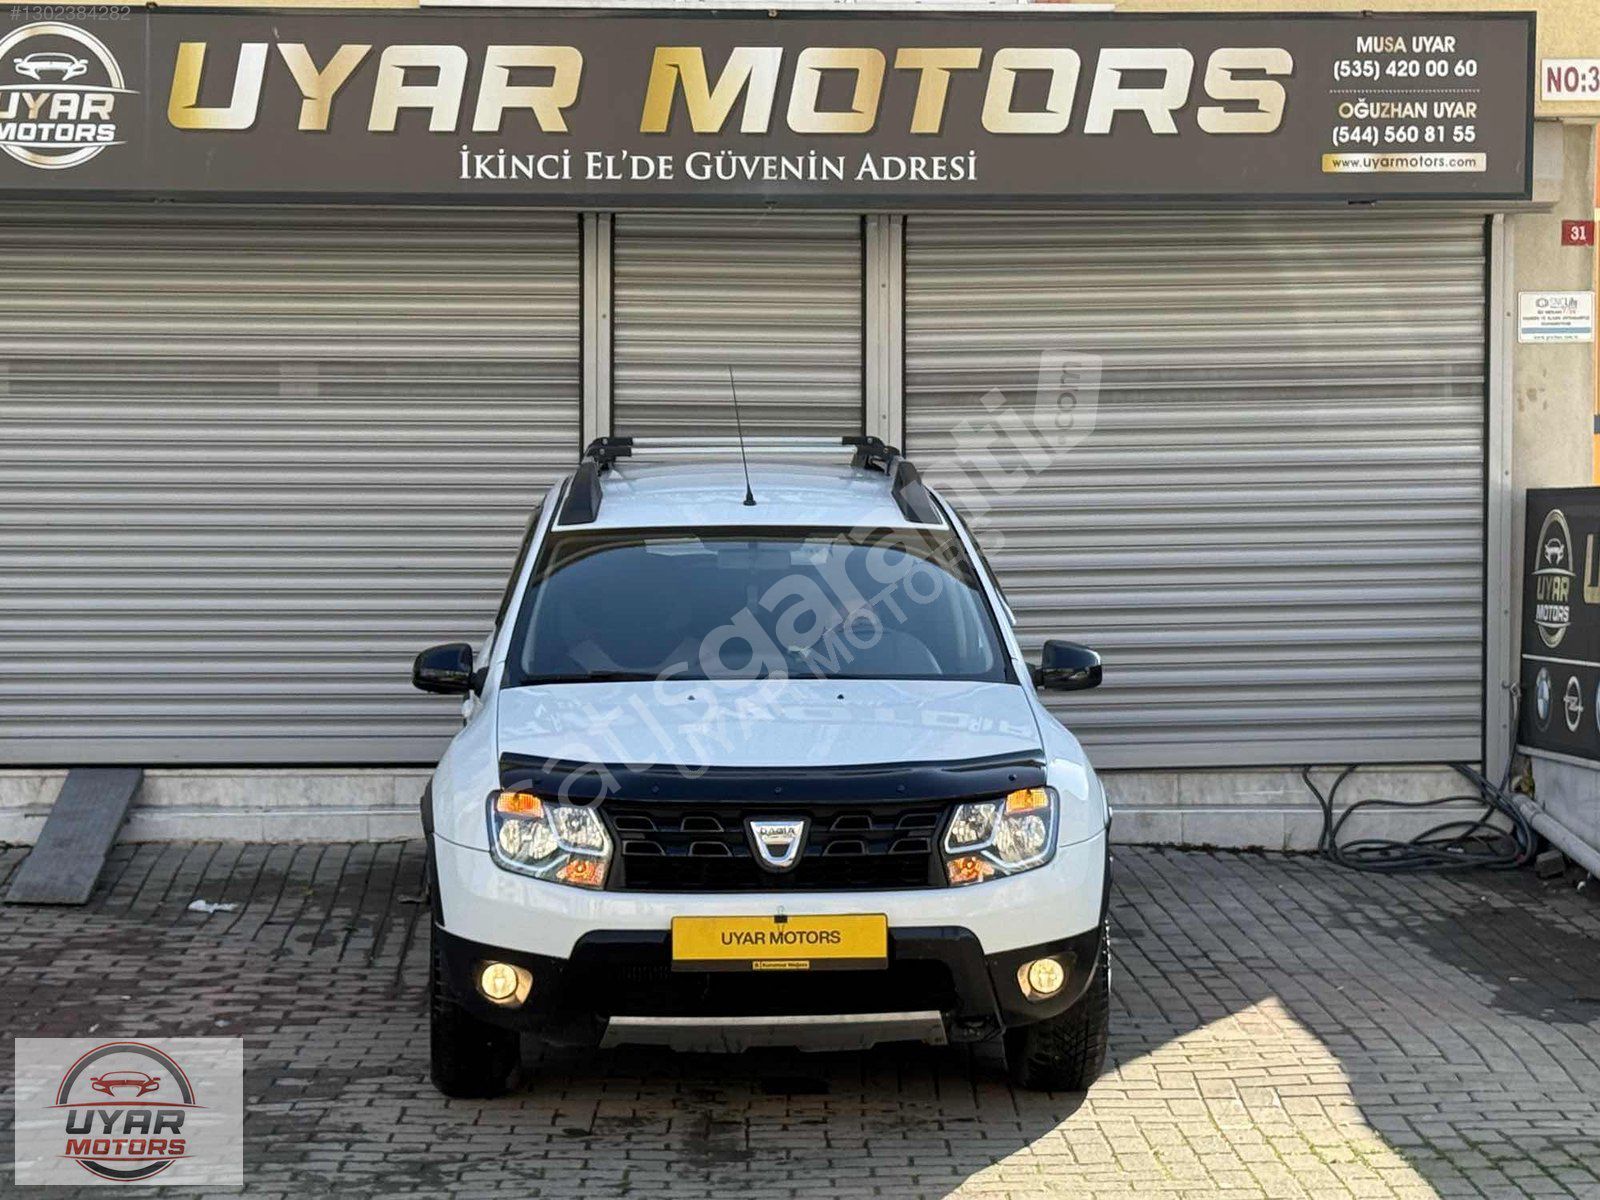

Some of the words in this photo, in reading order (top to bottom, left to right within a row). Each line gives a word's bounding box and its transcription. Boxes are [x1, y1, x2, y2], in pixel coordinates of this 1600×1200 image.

[1356, 36, 1407, 53] MUSA
[1412, 36, 1456, 53] UYAR
[1333, 60, 1380, 81] (535)
[1385, 60, 1420, 77] 420
[1425, 60, 1449, 77] 00
[1454, 60, 1478, 77] 60
[167, 42, 584, 133] UYAR
[639, 46, 1293, 134] MOTORS
[1339, 97, 1427, 118] OĞUZHAN
[1434, 102, 1477, 118] UYAR
[1332, 126, 1379, 146] (544)
[1384, 126, 1419, 143] 560
[1424, 126, 1445, 143] 81
[1452, 126, 1476, 142] 55
[459, 144, 572, 180] İKİNCİ
[685, 149, 846, 182] GÜVENİN
[855, 150, 978, 182] ADRESİ
[1332, 154, 1477, 169] www.uyarmotors.com
[1570, 225, 1587, 241] 31
[1536, 575, 1570, 602] UYAR
[1535, 604, 1570, 622] MOTORS
[721, 931, 766, 946] UYAR
[769, 930, 842, 946] MOTORS
